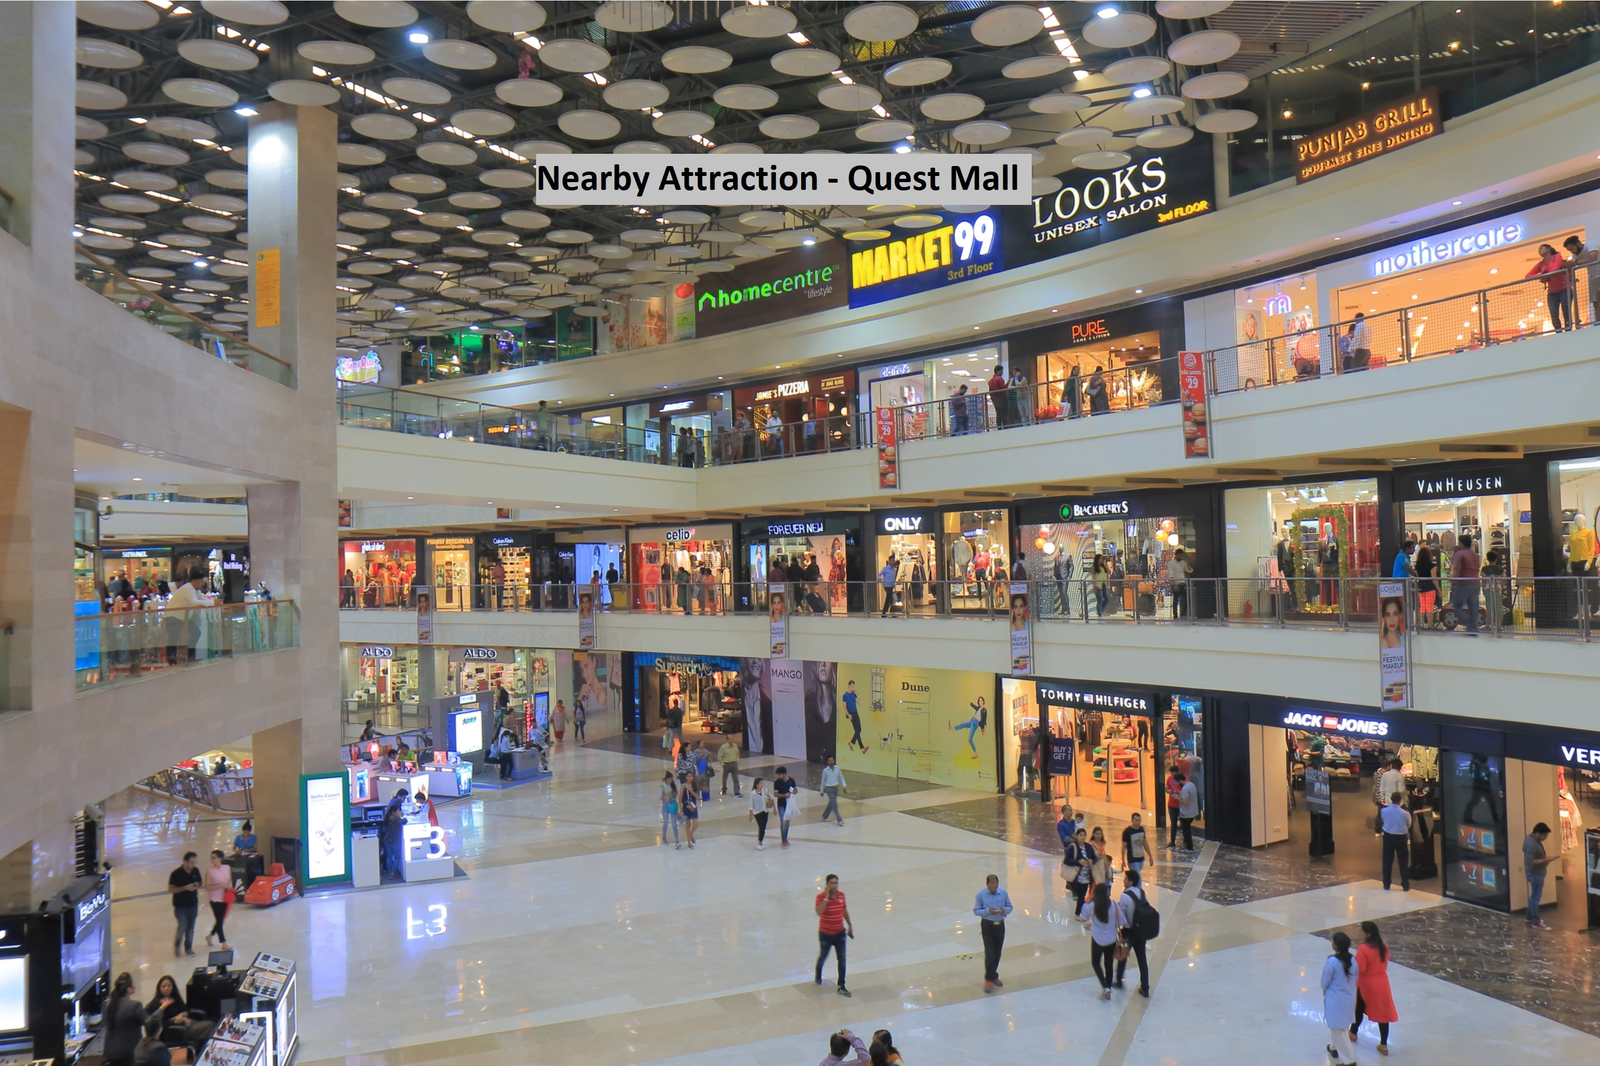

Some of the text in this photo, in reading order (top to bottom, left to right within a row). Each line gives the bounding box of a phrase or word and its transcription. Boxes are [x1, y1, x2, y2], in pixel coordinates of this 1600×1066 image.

[1299, 98, 1433, 161] PUNJAB GRILL
[1302, 123, 1434, 178] GOURMET FINE DINING
[1033, 156, 1167, 228] LOOKS
[1034, 193, 1168, 244] UNISEX SALON
[1157, 199, 1209, 223] 3rd FLOOR
[852, 215, 996, 289] MARKET 99
[1373, 222, 1522, 276] mothercare
[947, 262, 994, 281] 3rd Floor
[718, 266, 833, 308] homecentre
[807, 285, 833, 299] lifestyle
[1072, 319, 1109, 340] PURE
[755, 380, 810, 401] JAMIE'S PIZZERIA
[1073, 501, 1129, 517] BLACKBERRYS
[666, 527, 690, 541] celio
[767, 522, 824, 535] FOREVER NEW
[884, 516, 922, 531] ONLY
[362, 647, 393, 658] ALDO
[463, 647, 498, 659] ALDO
[655, 657, 705, 678] Superdry
[771, 668, 803, 679] MANGO
[901, 681, 930, 692] Dune
[1041, 688, 1147, 710] TOMMY HILFIGER
[1283, 712, 1389, 736] JACK JONES
[1053, 745, 1071, 754] BUY 2
[1053, 752, 1066, 760] GET
[404, 825, 447, 862] F3
